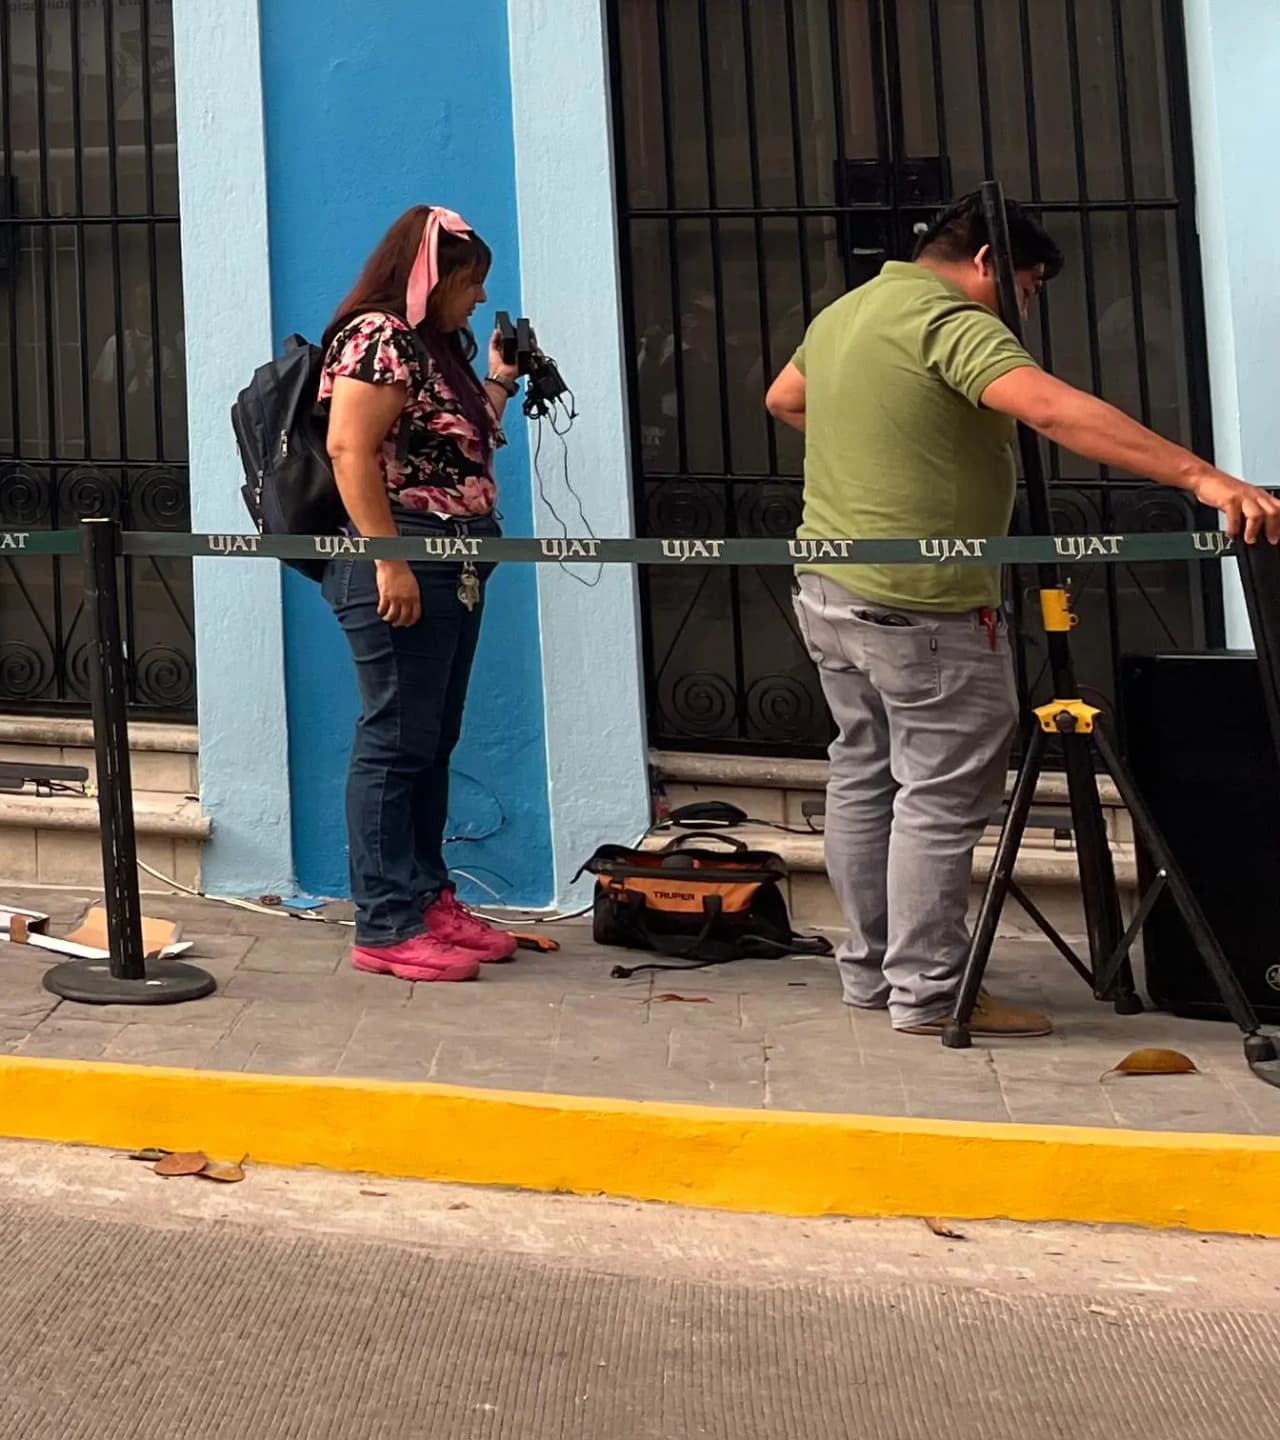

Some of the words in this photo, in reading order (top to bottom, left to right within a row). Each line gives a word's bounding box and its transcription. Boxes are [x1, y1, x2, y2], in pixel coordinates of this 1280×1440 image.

[208, 535, 261, 555] UJAT
[314, 536, 370, 557] UJAT
[424, 538, 482, 558] UJAT
[541, 539, 601, 559] UJAT
[660, 539, 724, 561] UJAT
[787, 539, 853, 561] UJAT
[918, 538, 987, 561] UJAT
[1053, 535, 1124, 557] UJAT
[1191, 532, 1232, 555] UJ
[653, 890, 695, 901] TRUPER
